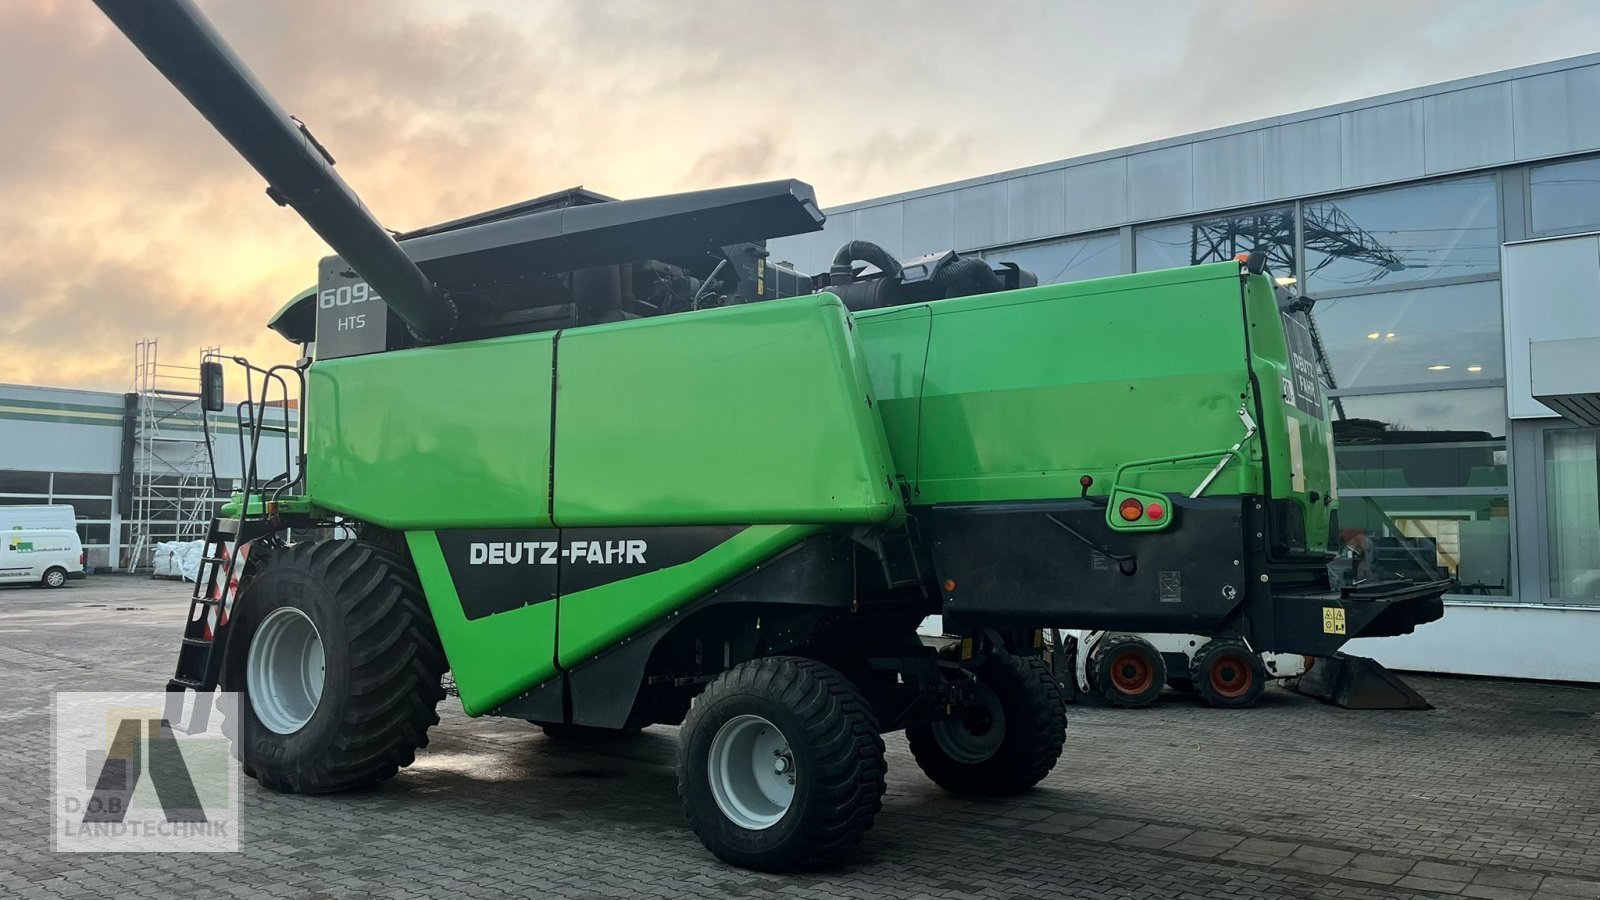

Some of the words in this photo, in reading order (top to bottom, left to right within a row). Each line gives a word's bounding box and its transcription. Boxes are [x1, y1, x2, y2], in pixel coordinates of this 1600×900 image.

[337, 314, 366, 331] HTS
[1293, 351, 1315, 378] DEUTZ
[469, 539, 648, 565] DEUTZ-FAHR
